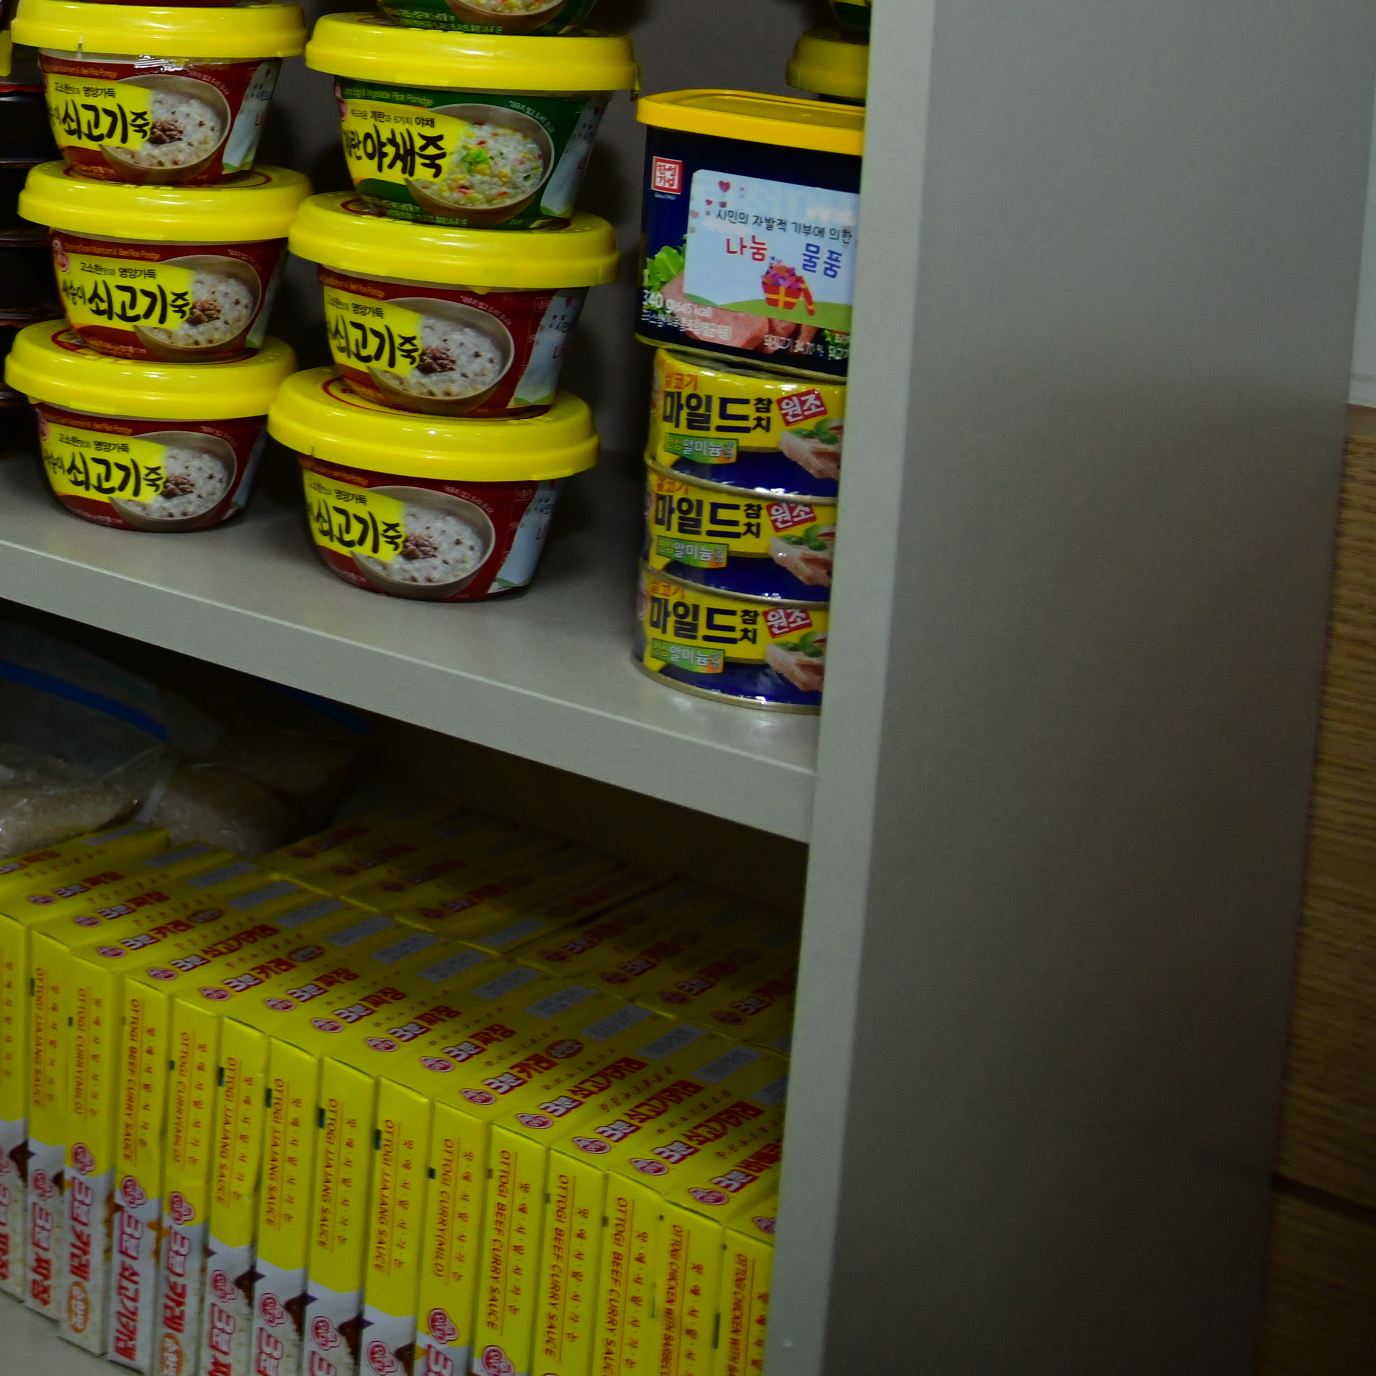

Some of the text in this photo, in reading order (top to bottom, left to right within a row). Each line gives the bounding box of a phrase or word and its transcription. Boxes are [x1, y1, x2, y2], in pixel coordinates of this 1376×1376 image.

[715, 207, 853, 245] 시민의 자발적 기부에 의한
[725, 234, 843, 280] 나눔 물품
[662, 390, 751, 434] 마일드
[780, 392, 825, 423] 원조
[654, 495, 743, 539] 마일드
[770, 502, 814, 530] 원조
[650, 594, 739, 645] 마일드
[766, 608, 811, 636] 원조
[333, 1000, 375, 1024] 3분
[539, 1092, 584, 1120] 3분
[596, 1116, 642, 1144] 3분
[653, 1139, 700, 1167] 3분
[487, 1148, 511, 1331] OTTOGI BEEF CURRY SAUCE
[544, 1172, 570, 1359] OTTOGI BEEF CURRY SAUCE
